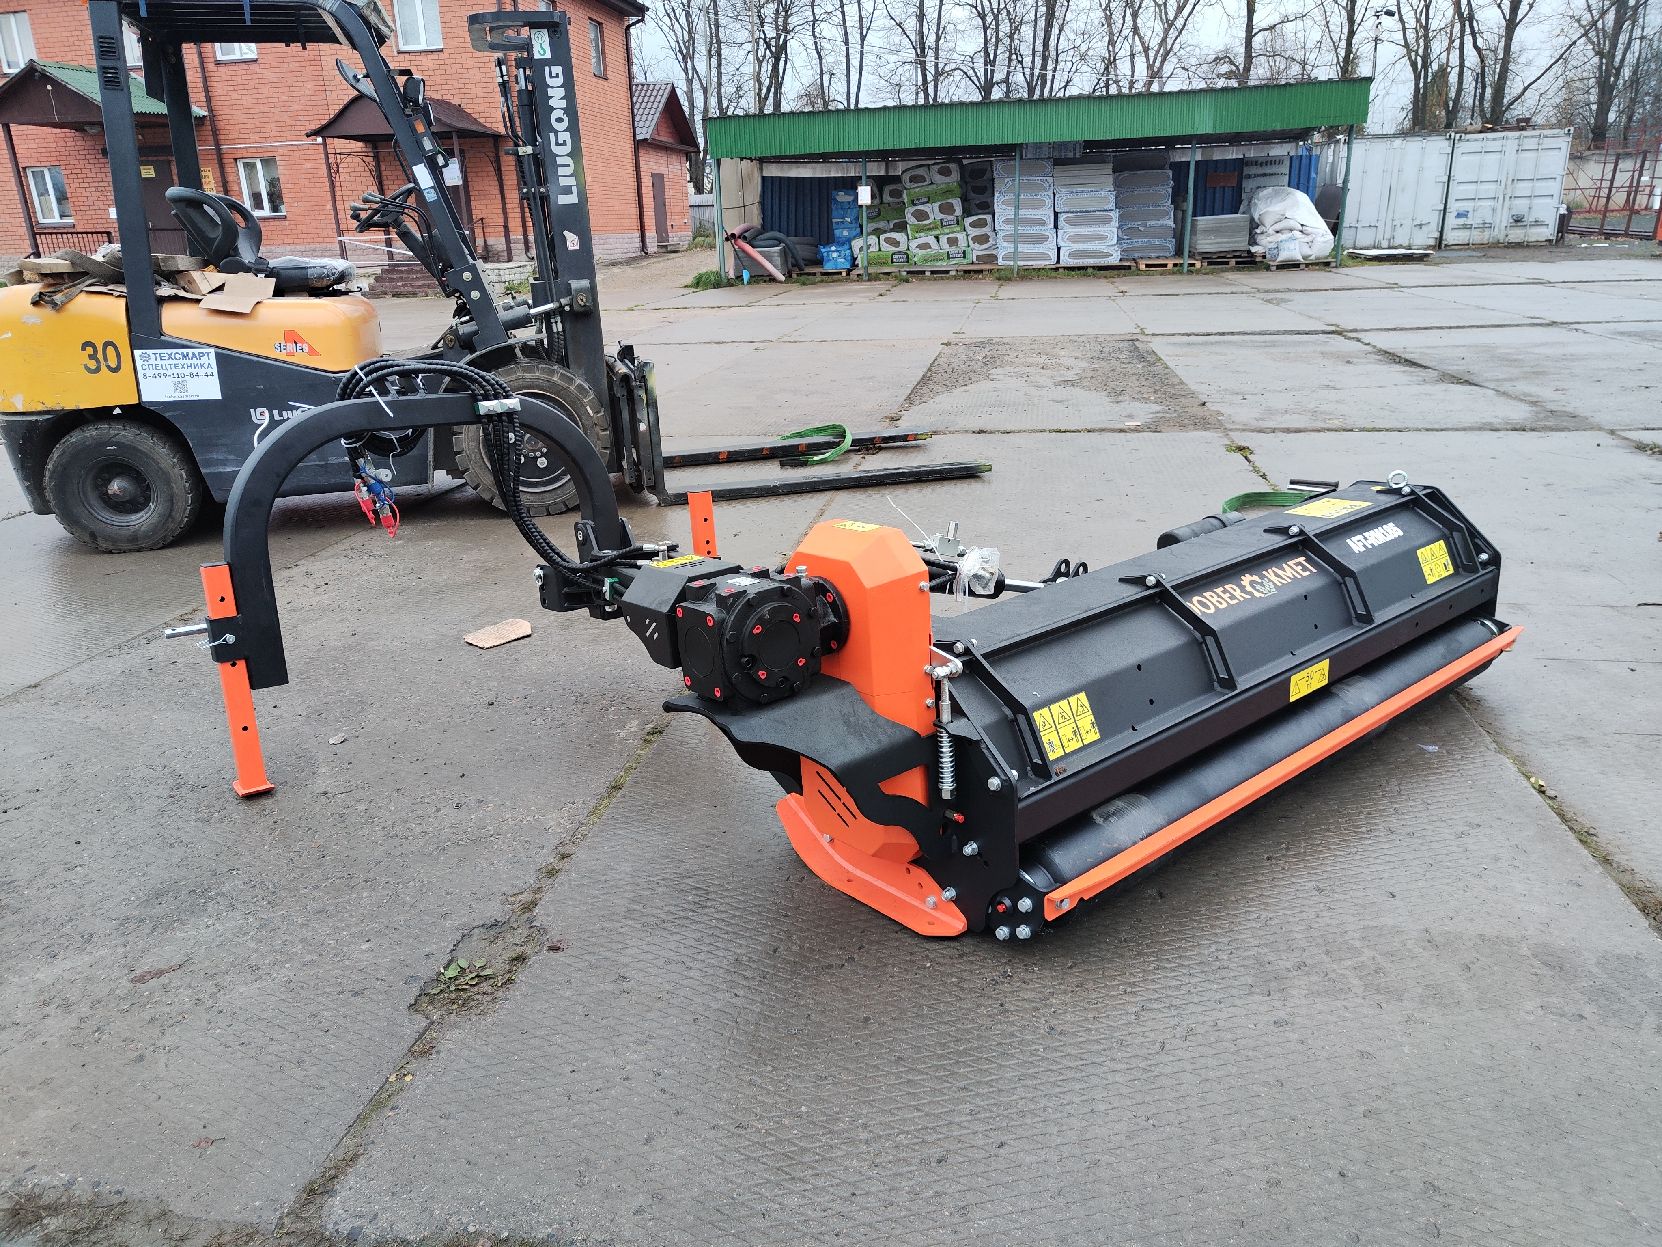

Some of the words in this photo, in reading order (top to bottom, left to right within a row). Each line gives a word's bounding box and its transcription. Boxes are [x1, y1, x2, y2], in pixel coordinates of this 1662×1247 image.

[545, 65, 579, 205] LIUGONG
[81, 340, 122, 374] 30
[151, 351, 211, 361] ТЕХСМАРТ
[274, 342, 309, 352] SERIES
[141, 362, 214, 371] СПЕЦТЕХНИКА
[1262, 556, 1318, 587] KMET
